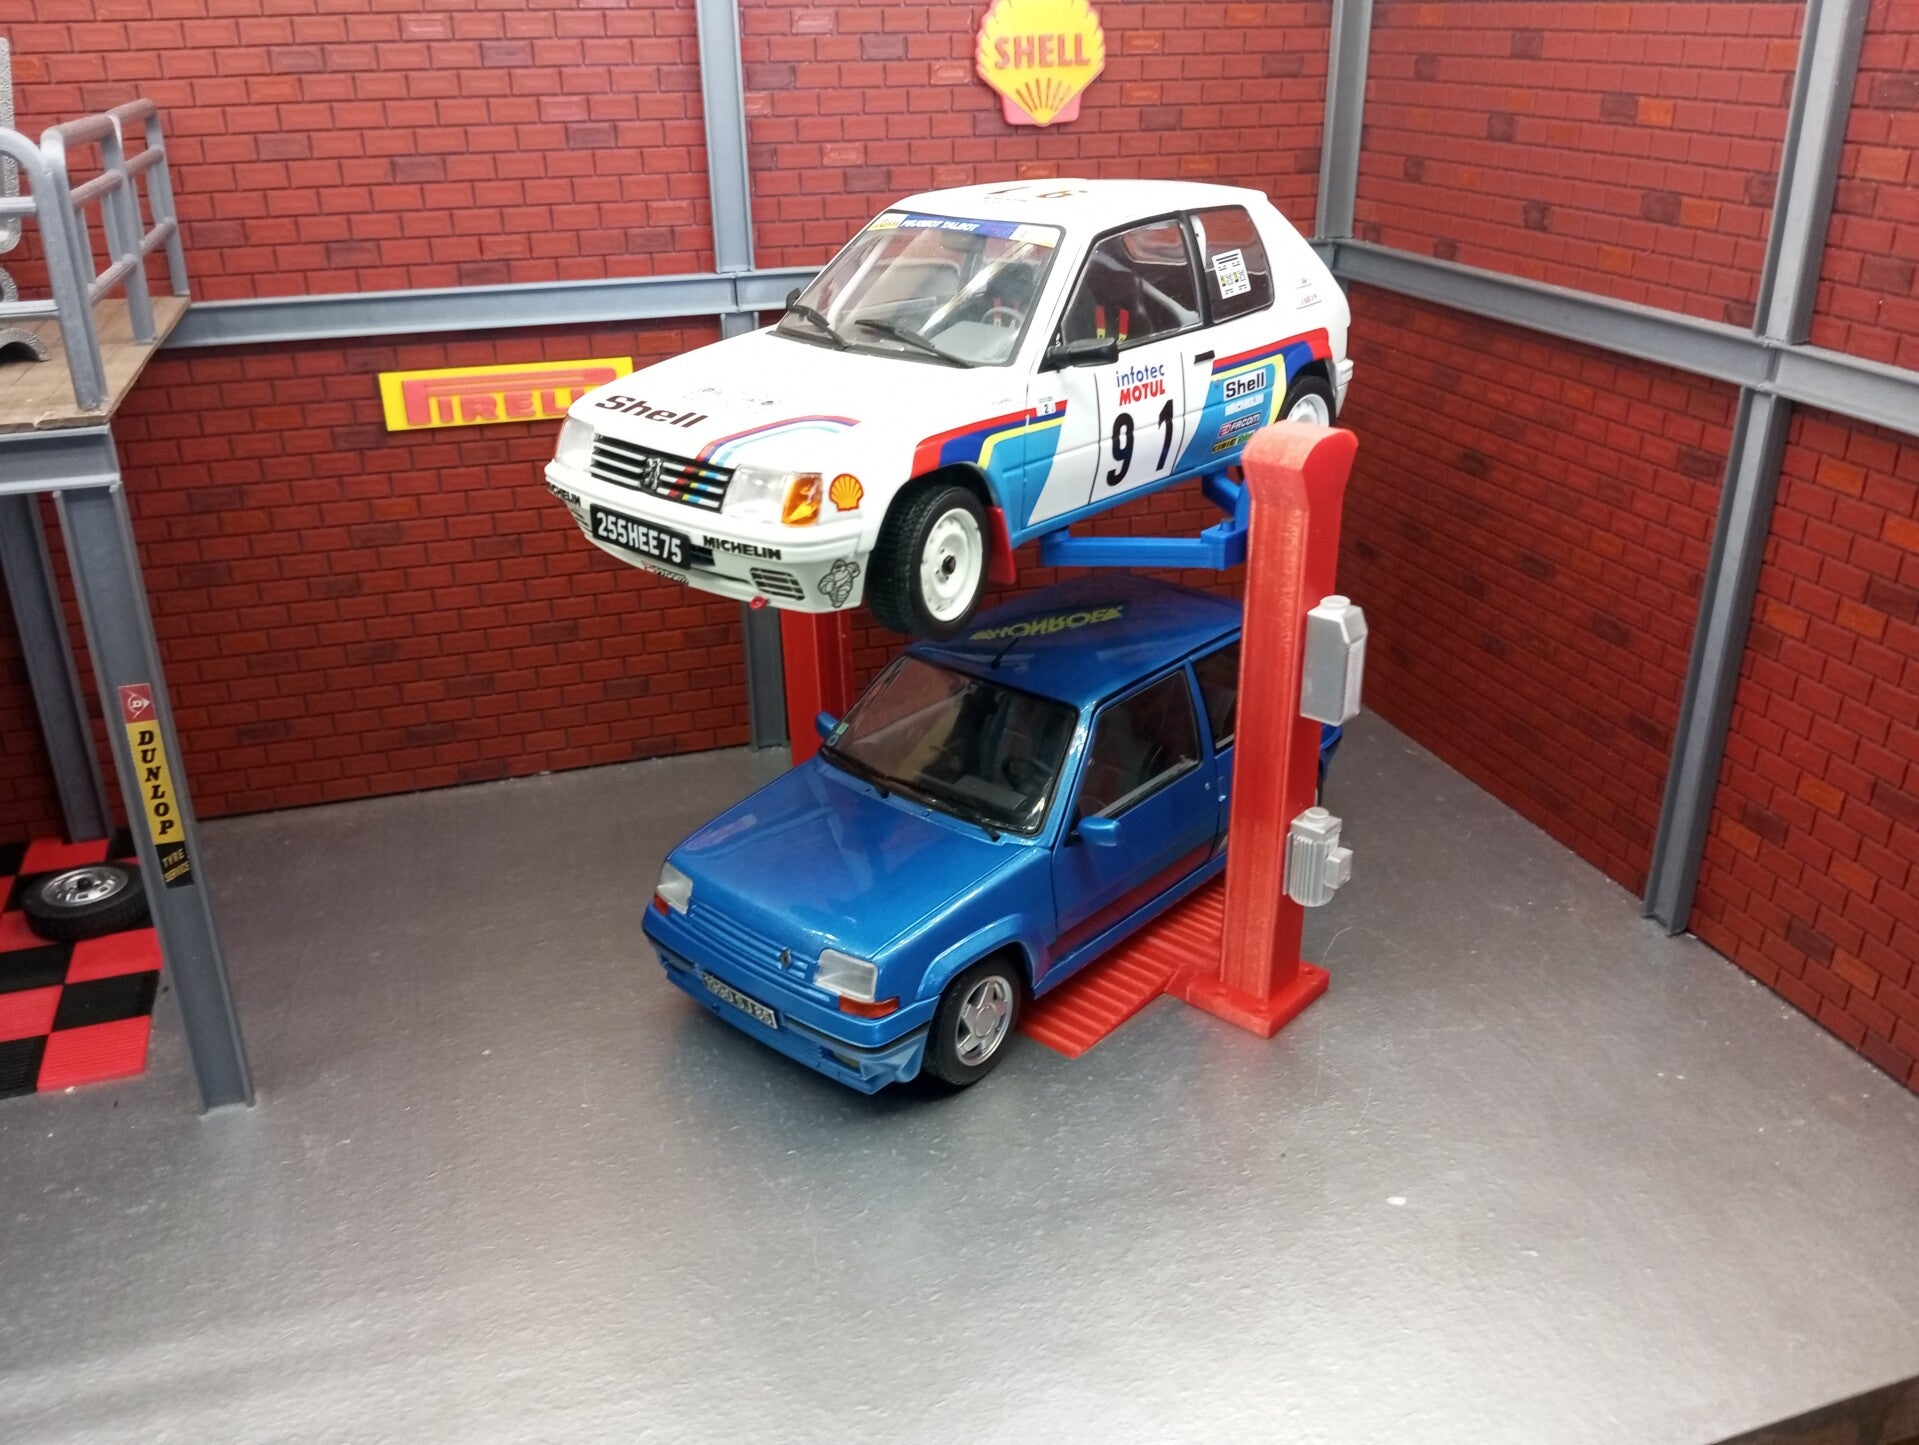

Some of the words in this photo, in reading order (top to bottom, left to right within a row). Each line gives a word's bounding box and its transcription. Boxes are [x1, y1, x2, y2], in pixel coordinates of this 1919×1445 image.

[994, 33, 1091, 69] SHELL
[1116, 364, 1165, 388] infotec
[1119, 379, 1165, 406] MOTUL
[1226, 372, 1264, 398] Shell
[402, 367, 617, 426] PIREL
[595, 395, 709, 428] Shell
[596, 511, 682, 563] 255HEE75
[703, 535, 782, 560] MICHELIN
[138, 730, 174, 836] DUNLOP
